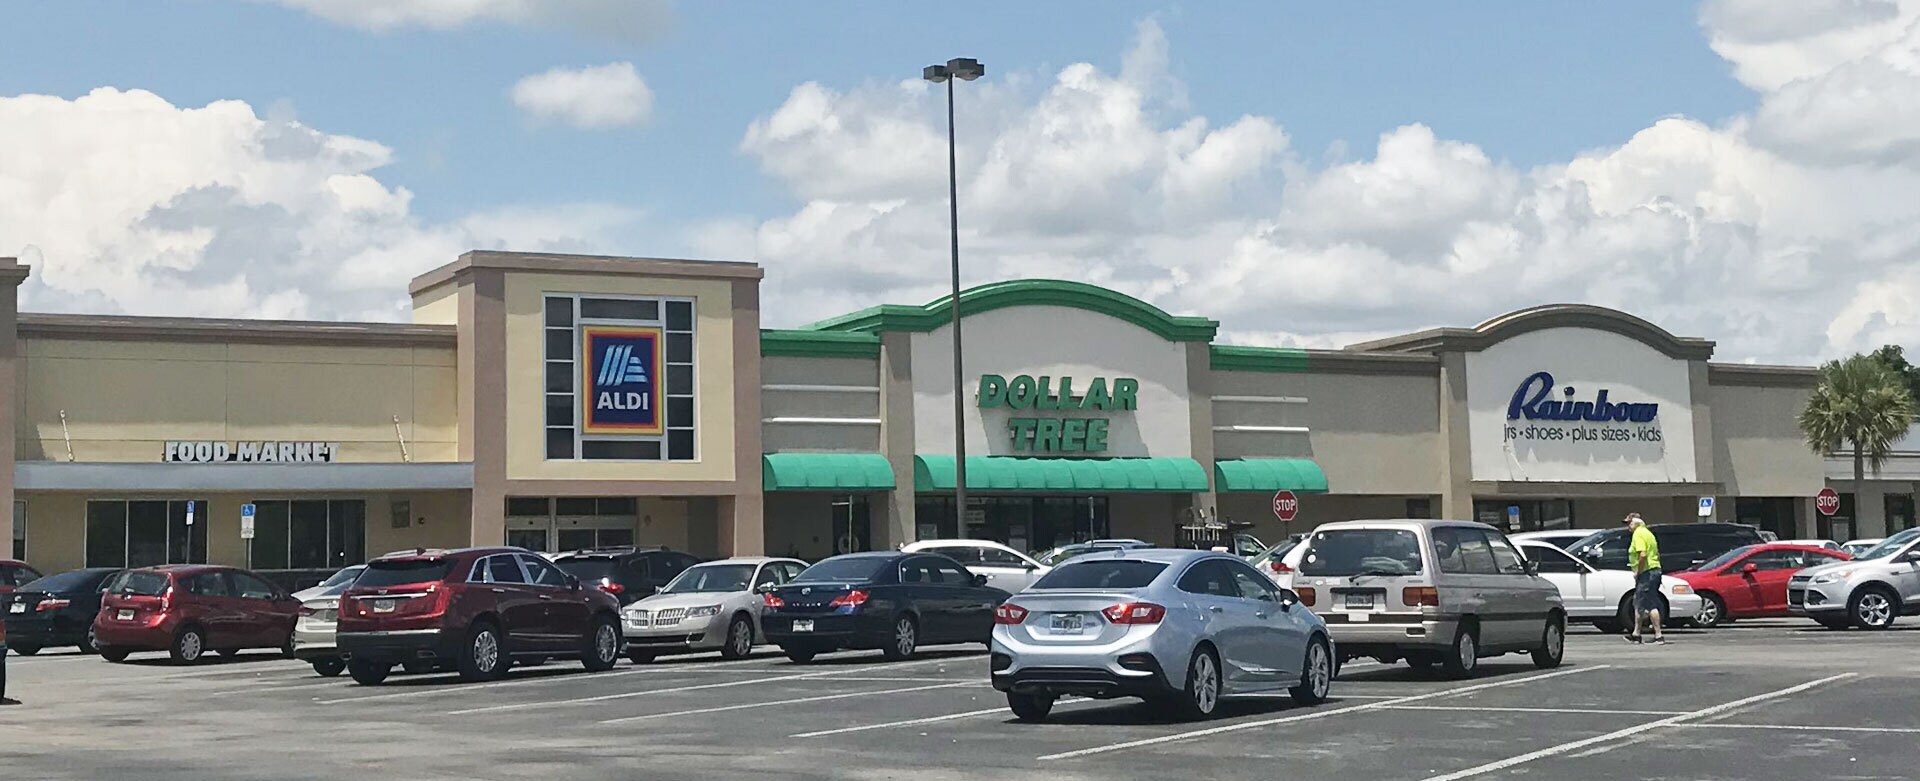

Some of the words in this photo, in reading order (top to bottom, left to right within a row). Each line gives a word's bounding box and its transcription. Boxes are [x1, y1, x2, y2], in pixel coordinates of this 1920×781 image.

[597, 391, 648, 410] ALDI
[978, 374, 1138, 411] DOLLAR
[1507, 371, 1658, 422] Rainbow
[1008, 417, 1109, 451] TREE
[1503, 424, 1517, 442] jrs
[1525, 424, 1563, 440] shoes
[1572, 425, 1598, 443] plus
[1601, 425, 1630, 441] sizes
[1637, 426, 1662, 441] kids
[164, 441, 230, 463] FOOD
[236, 441, 340, 463] MARKET
[1275, 499, 1296, 512] STOP
[1818, 495, 1838, 507] STOP
